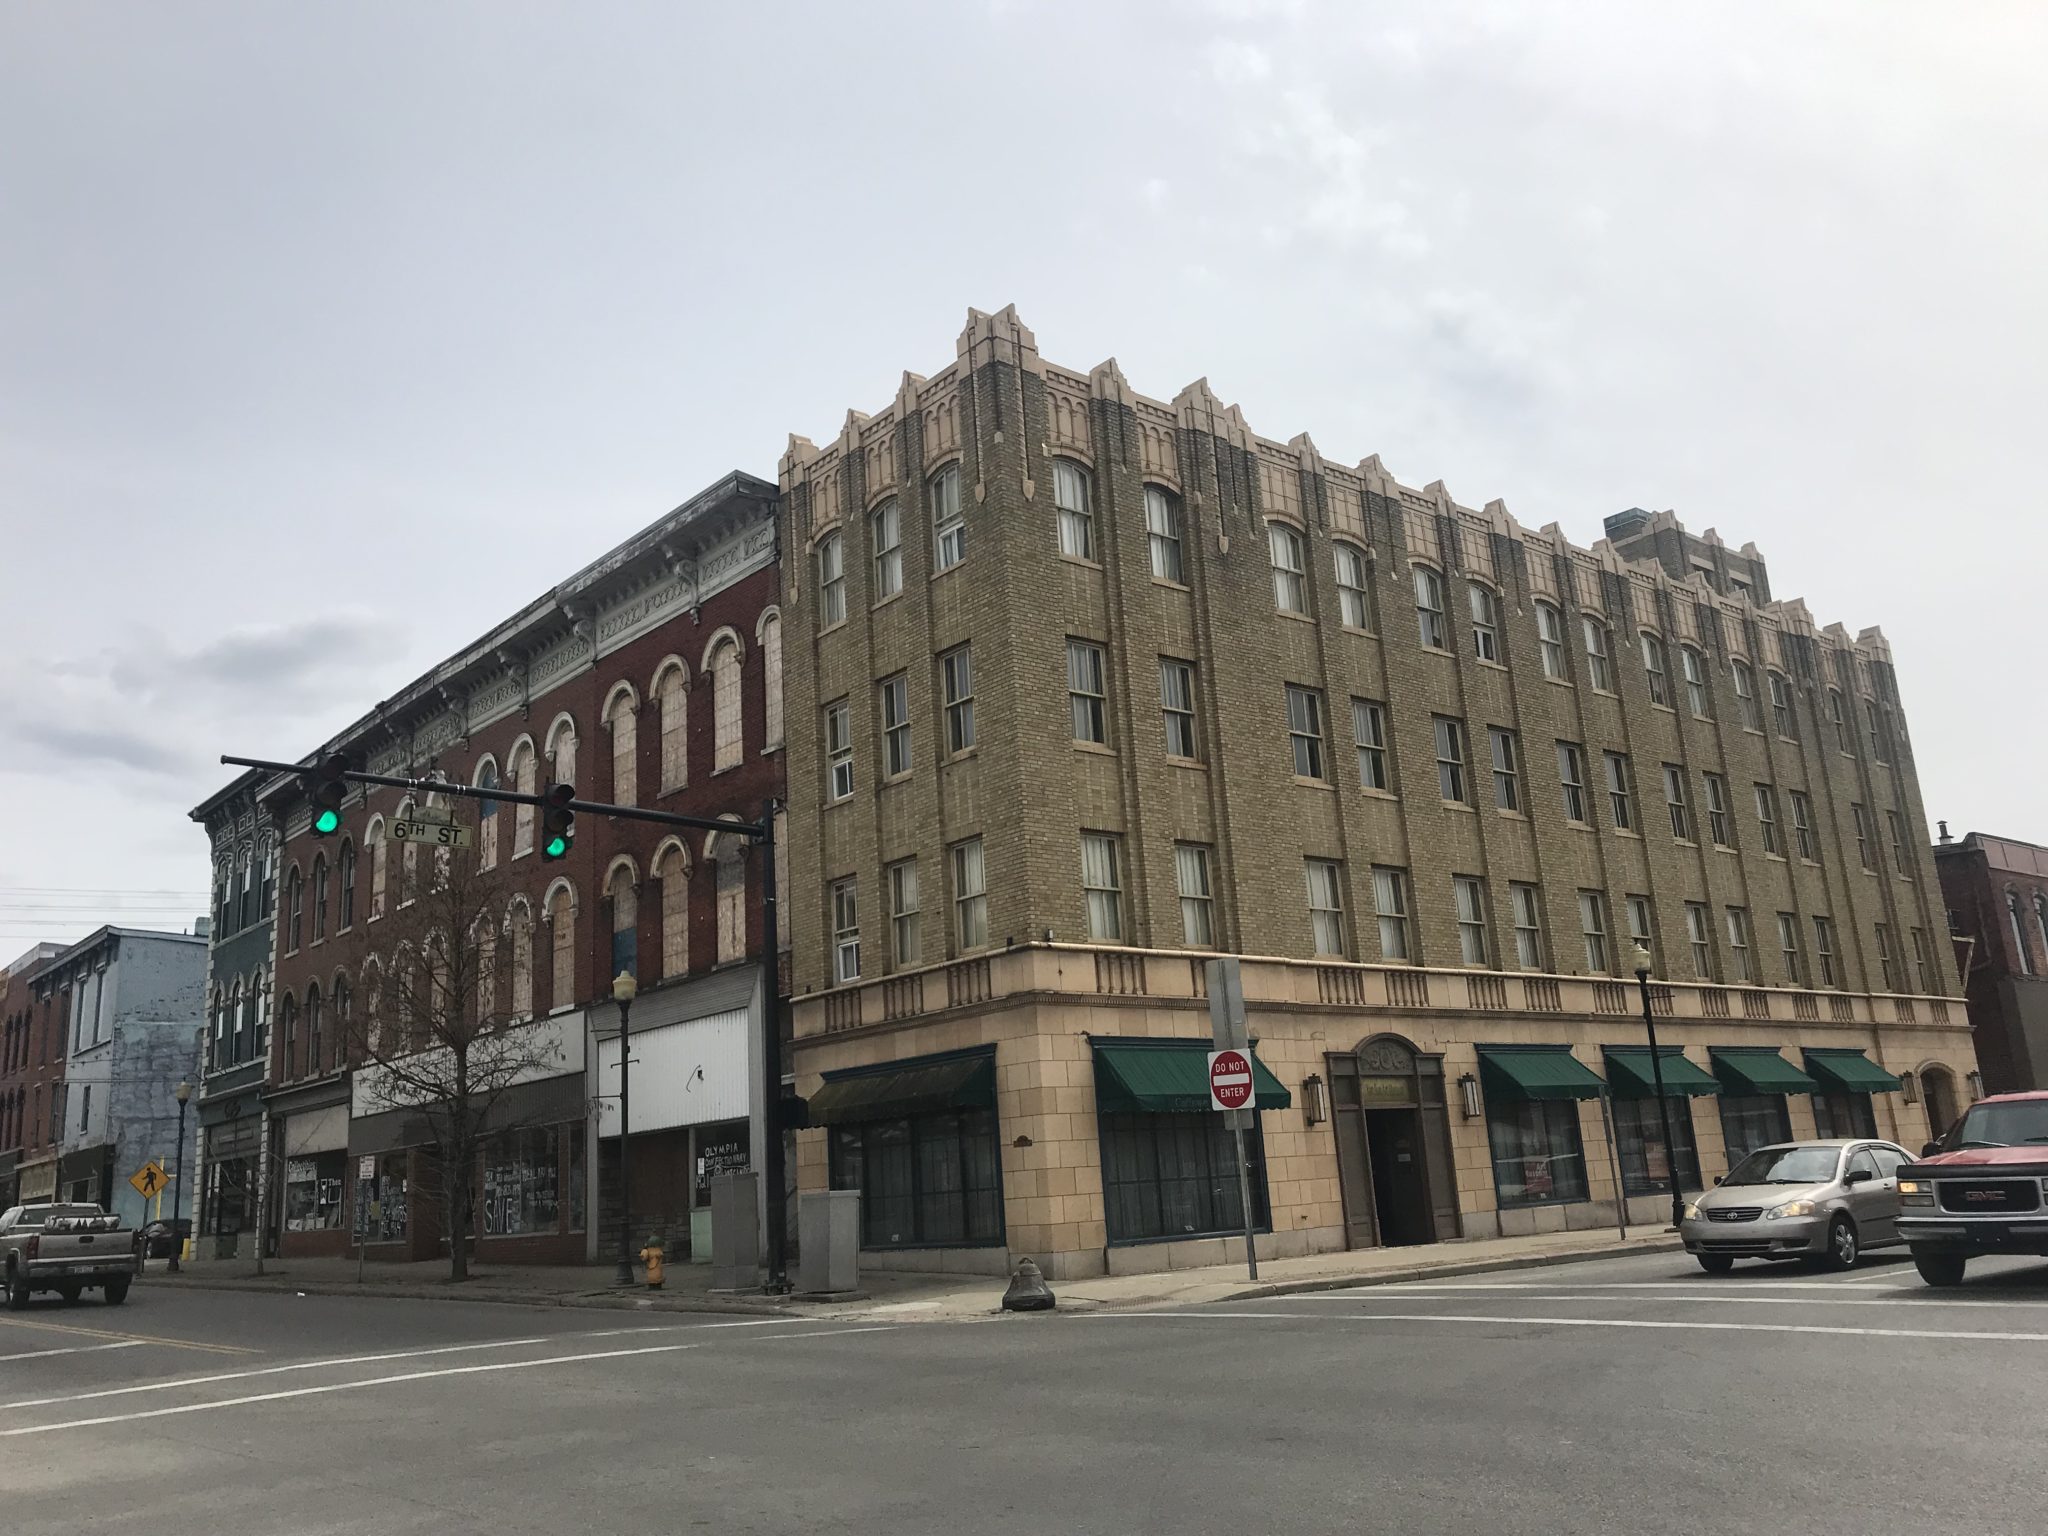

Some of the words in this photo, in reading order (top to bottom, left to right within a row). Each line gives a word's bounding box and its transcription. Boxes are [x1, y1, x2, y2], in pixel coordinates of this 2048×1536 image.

[394, 822, 426, 838] 6TH
[437, 827, 463, 845] ST.
[1215, 1063, 1226, 1073] DO
[1228, 1061, 1245, 1071] NOT
[1220, 1087, 1245, 1098] ENTER
[704, 1142, 739, 1158] OLYMPIA
[1965, 1190, 2007, 1201] GMC
[484, 1197, 513, 1234] SAVE
